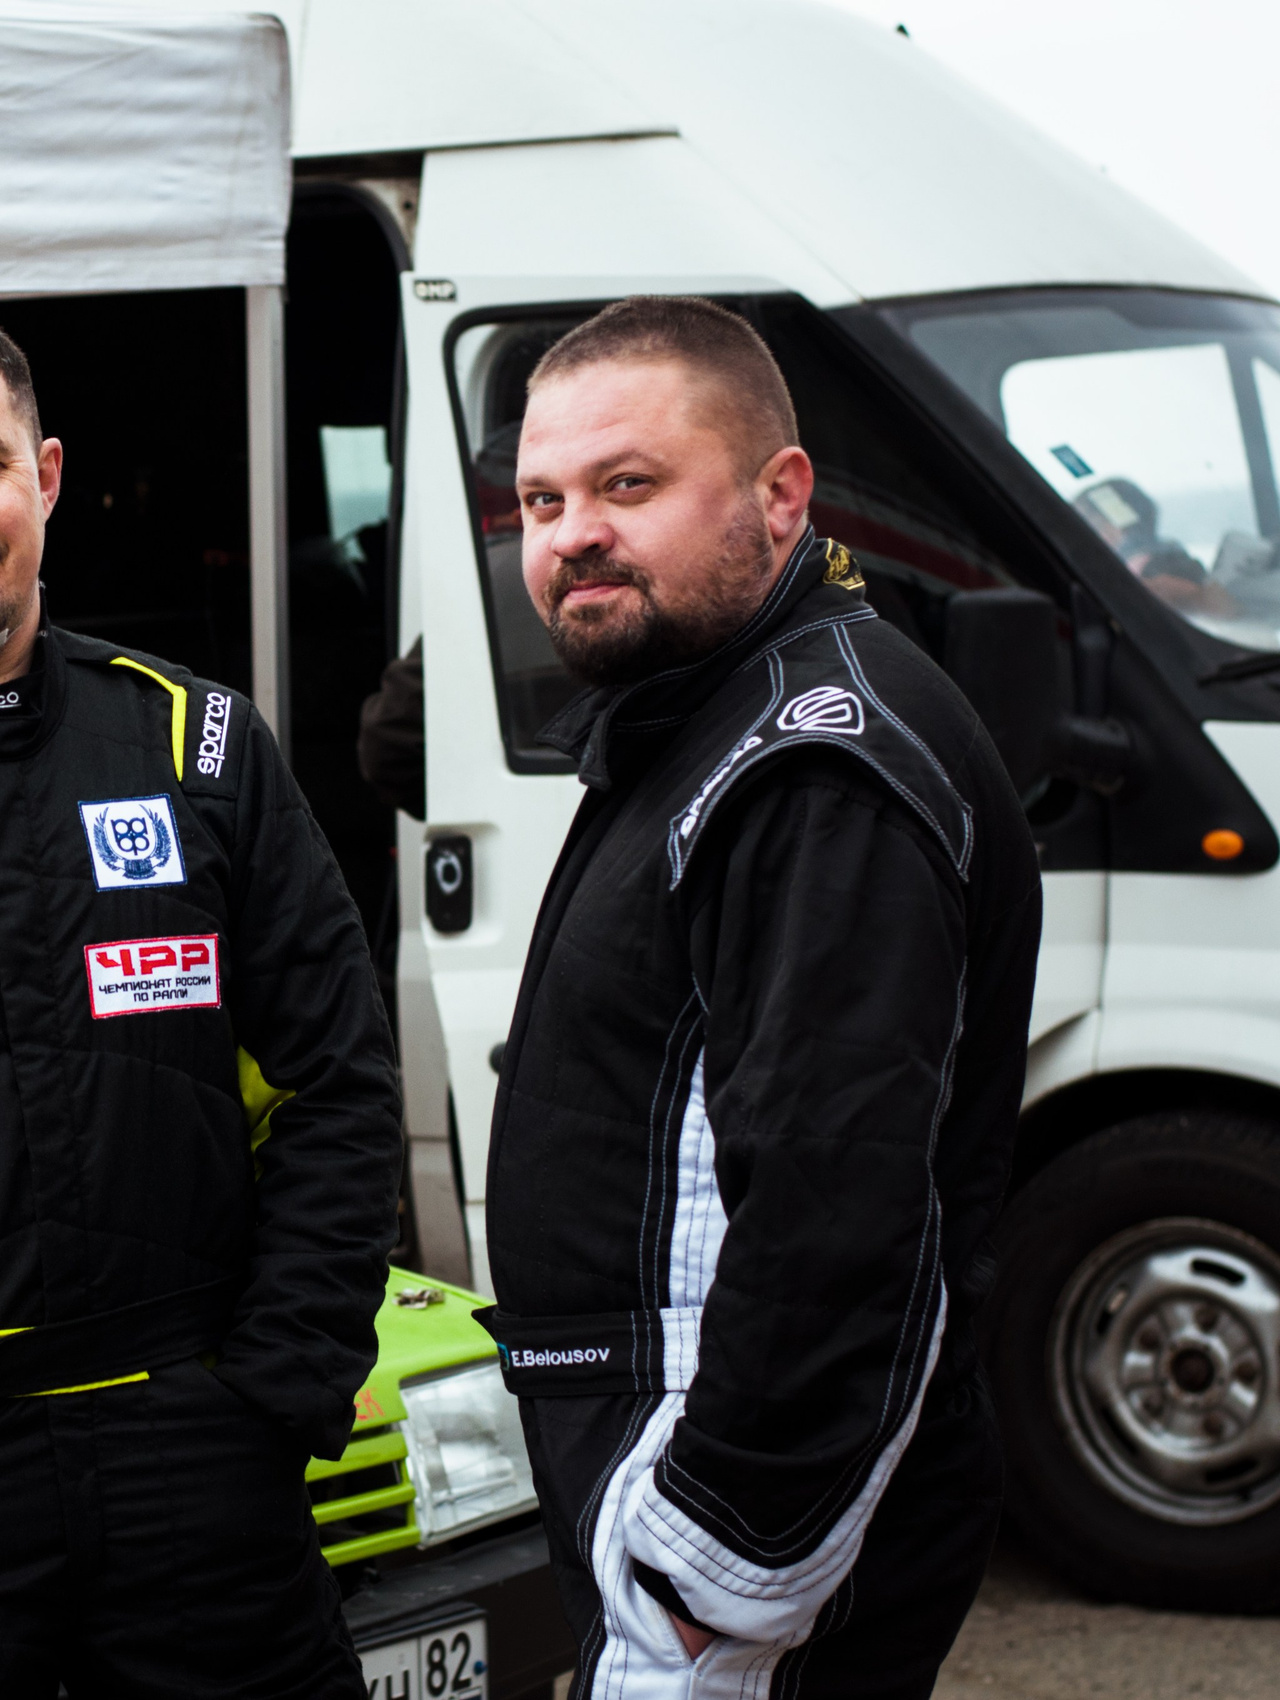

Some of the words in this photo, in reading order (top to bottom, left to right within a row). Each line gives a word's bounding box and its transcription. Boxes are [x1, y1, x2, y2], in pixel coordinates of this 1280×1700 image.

[196, 691, 233, 779] sparco
[96, 942, 210, 977] ЧРР
[99, 978, 172, 995] ЧЕМПИОНАТ
[175, 975, 211, 988] РОССИИ
[133, 992, 150, 1003] ПО
[153, 988, 189, 1001] РАЛЛИ
[510, 1347, 611, 1368] E.Belousov
[426, 1631, 472, 1698] 82
